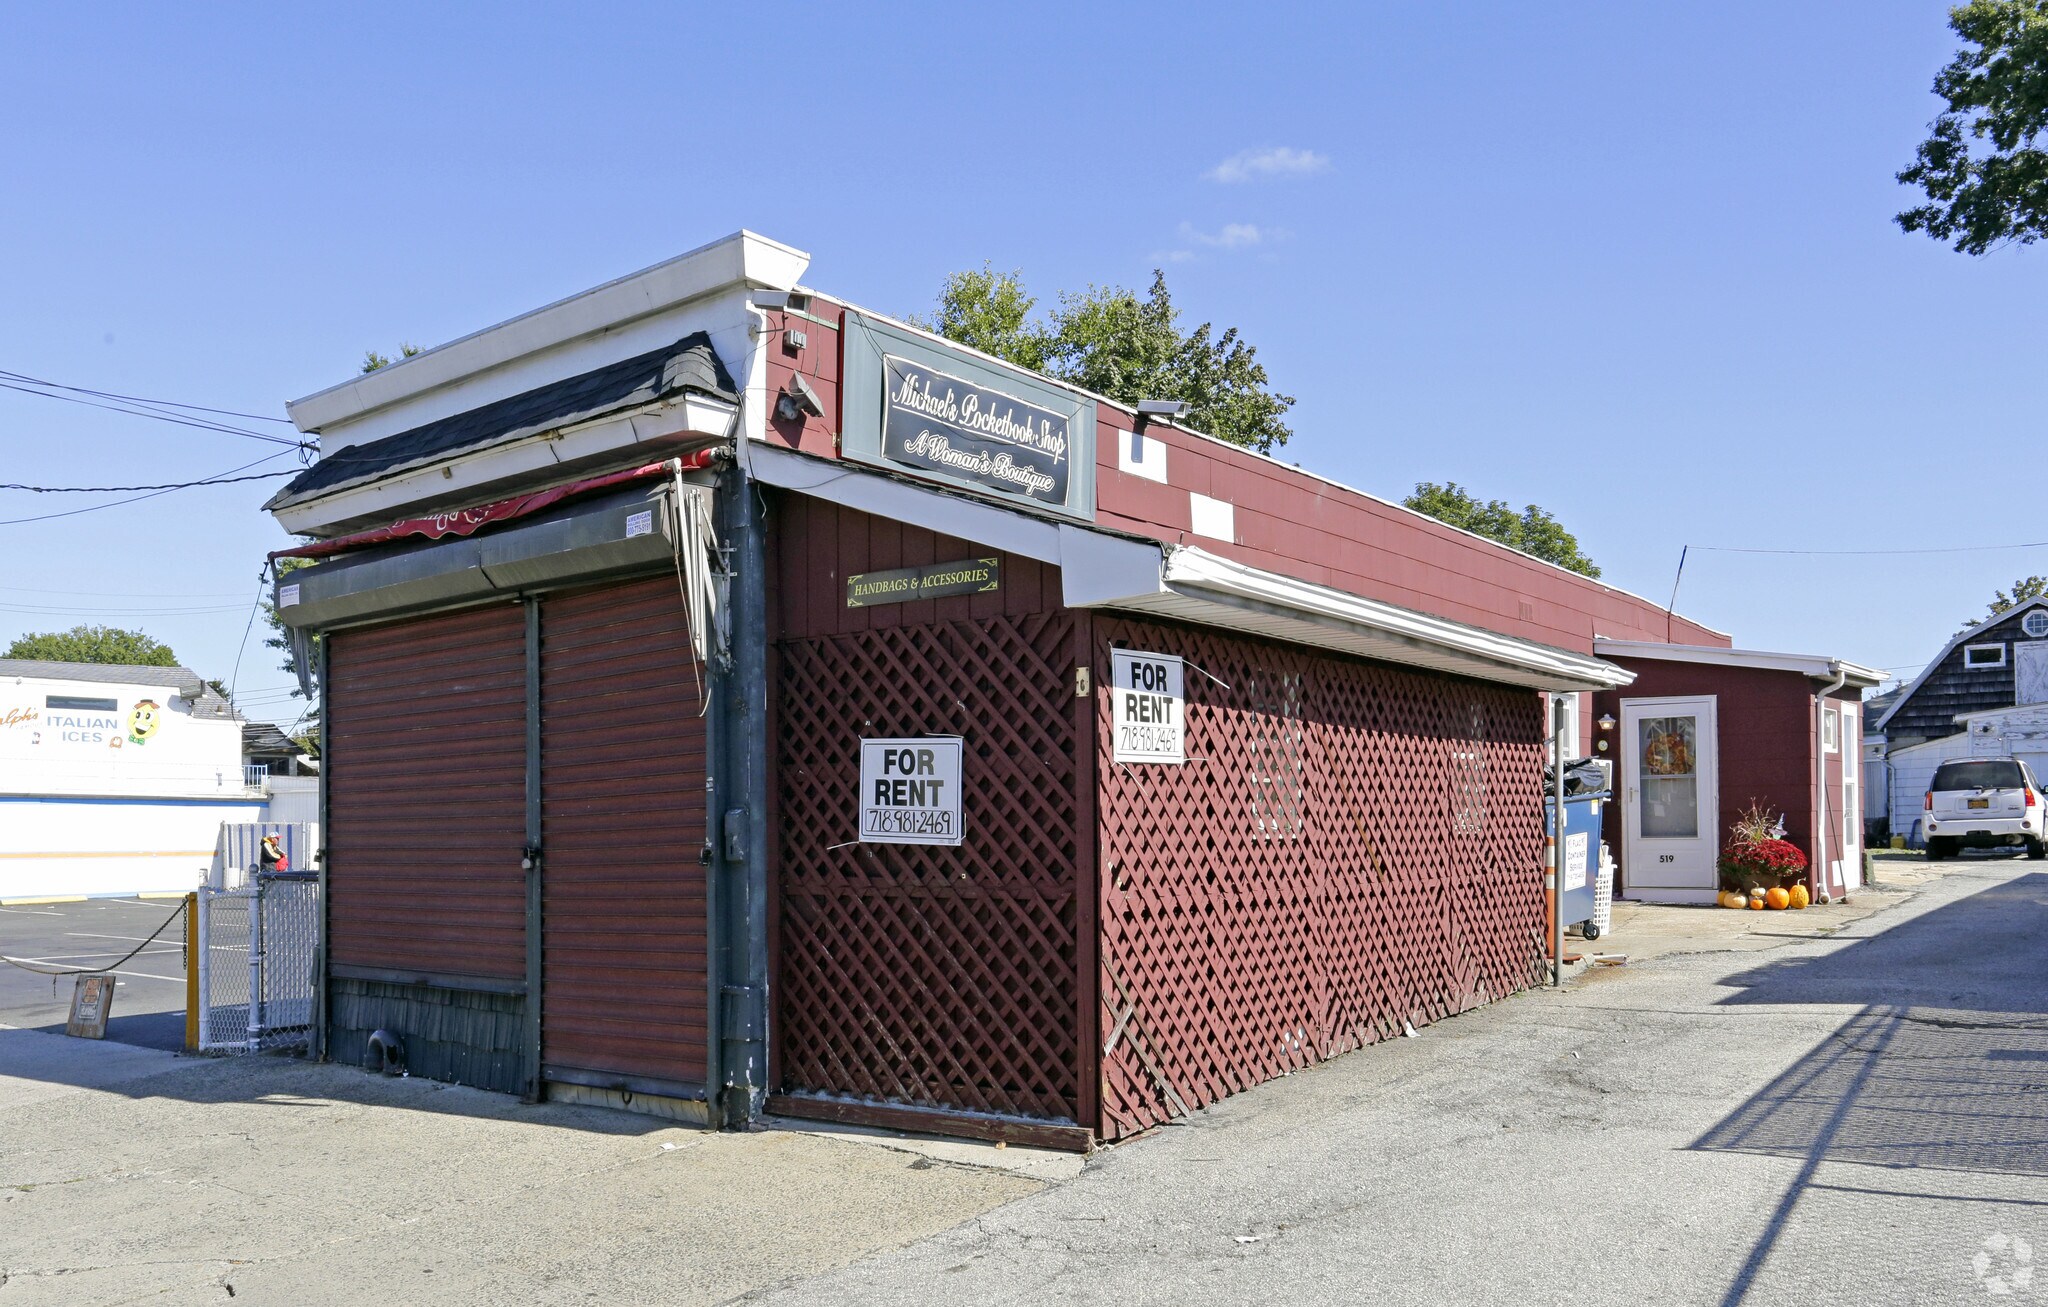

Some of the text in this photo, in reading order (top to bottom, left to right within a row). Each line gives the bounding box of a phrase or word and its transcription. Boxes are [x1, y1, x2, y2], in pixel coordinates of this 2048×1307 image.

[892, 373, 1067, 465] Michael's Pocketbook Shop
[904, 430, 1056, 496] A Woman's Boutique
[854, 568, 989, 596] HANDBAGS & ACCESSORIES
[1131, 661, 1168, 692] FOR
[47, 716, 118, 729] ITALIAN
[1125, 693, 1173, 724] RENT
[62, 731, 103, 743] ICES
[884, 748, 935, 775] FOR
[875, 779, 944, 807] RENT
[1659, 854, 1674, 863] 519
